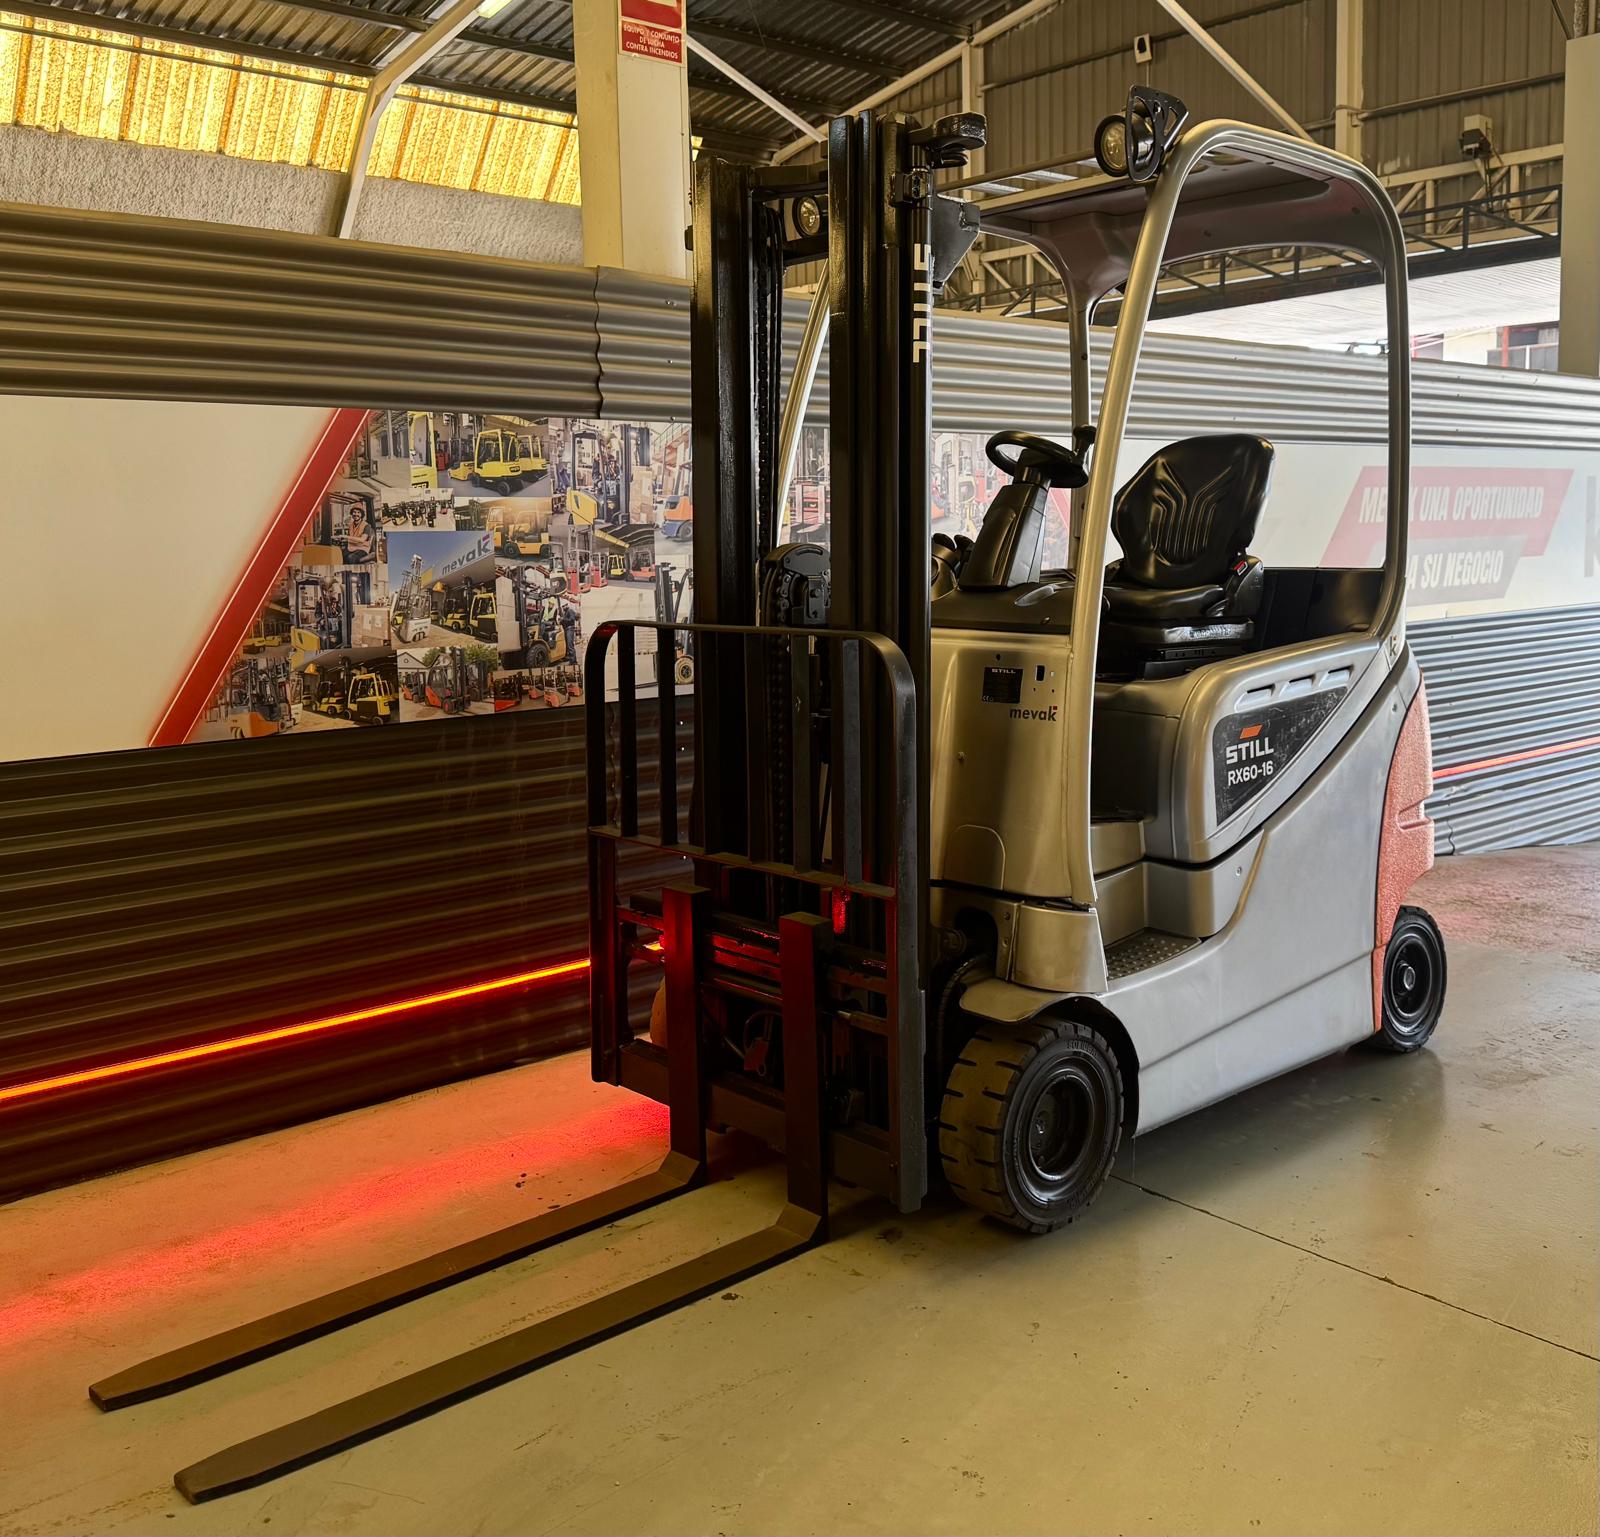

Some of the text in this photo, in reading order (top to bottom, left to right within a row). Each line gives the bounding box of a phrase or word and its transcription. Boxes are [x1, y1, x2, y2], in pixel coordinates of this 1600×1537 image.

[623, 24, 645, 35] EQUIPO
[650, 30, 680, 43] CONJUNTO
[639, 36, 646, 44] DE
[625, 41, 678, 59] CONTRA INCENDIOS
[1419, 487, 1450, 522] UNA
[1451, 486, 1545, 520] OPORTUNIDAD
[442, 535, 492, 576] mevak
[1420, 553, 1443, 590] SU
[1443, 550, 1504, 588] NEGOCIO
[1009, 705, 1057, 721] mevak
[1225, 737, 1275, 765] STILL
[1227, 760, 1274, 787] RX60-16
